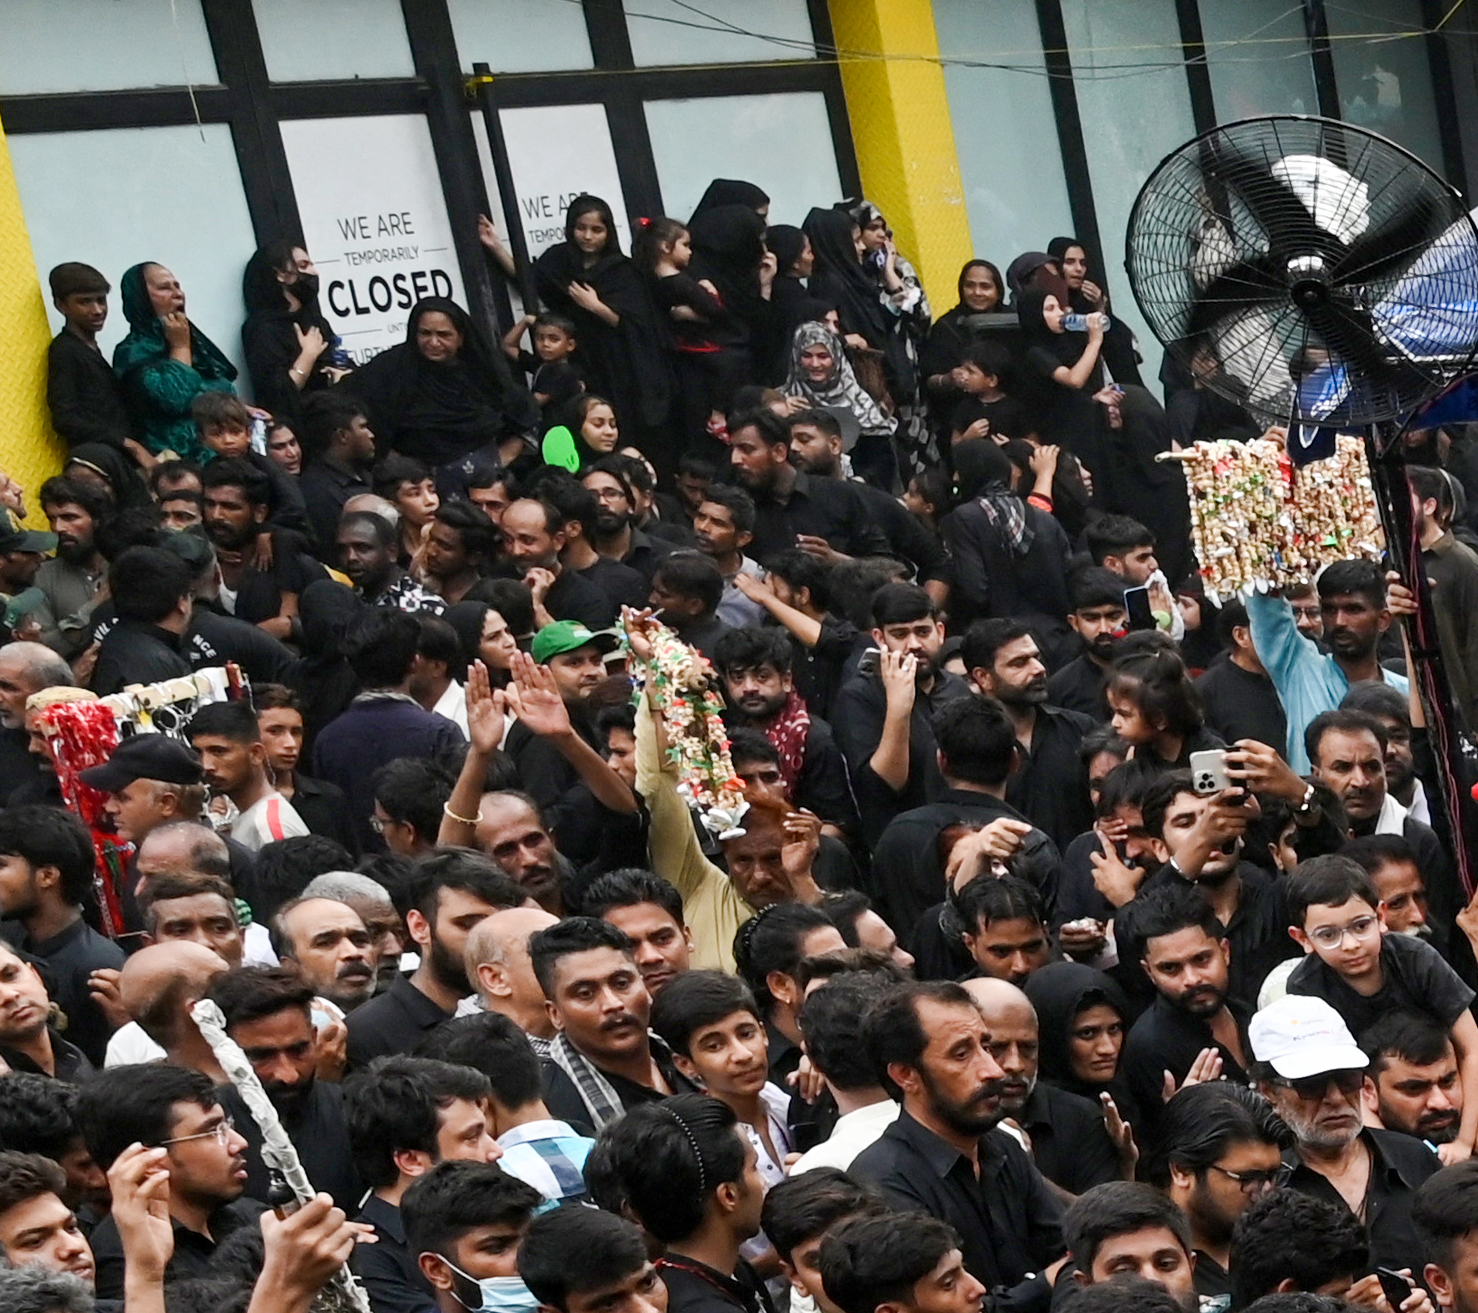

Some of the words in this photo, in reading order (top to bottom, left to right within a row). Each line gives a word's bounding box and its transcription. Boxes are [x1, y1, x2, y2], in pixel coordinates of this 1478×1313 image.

[522, 195, 553, 219] WE
[337, 215, 371, 241] WE
[377, 211, 415, 238] ARE
[343, 245, 419, 266] TEMPORARILY
[328, 269, 452, 317] CLOSED
